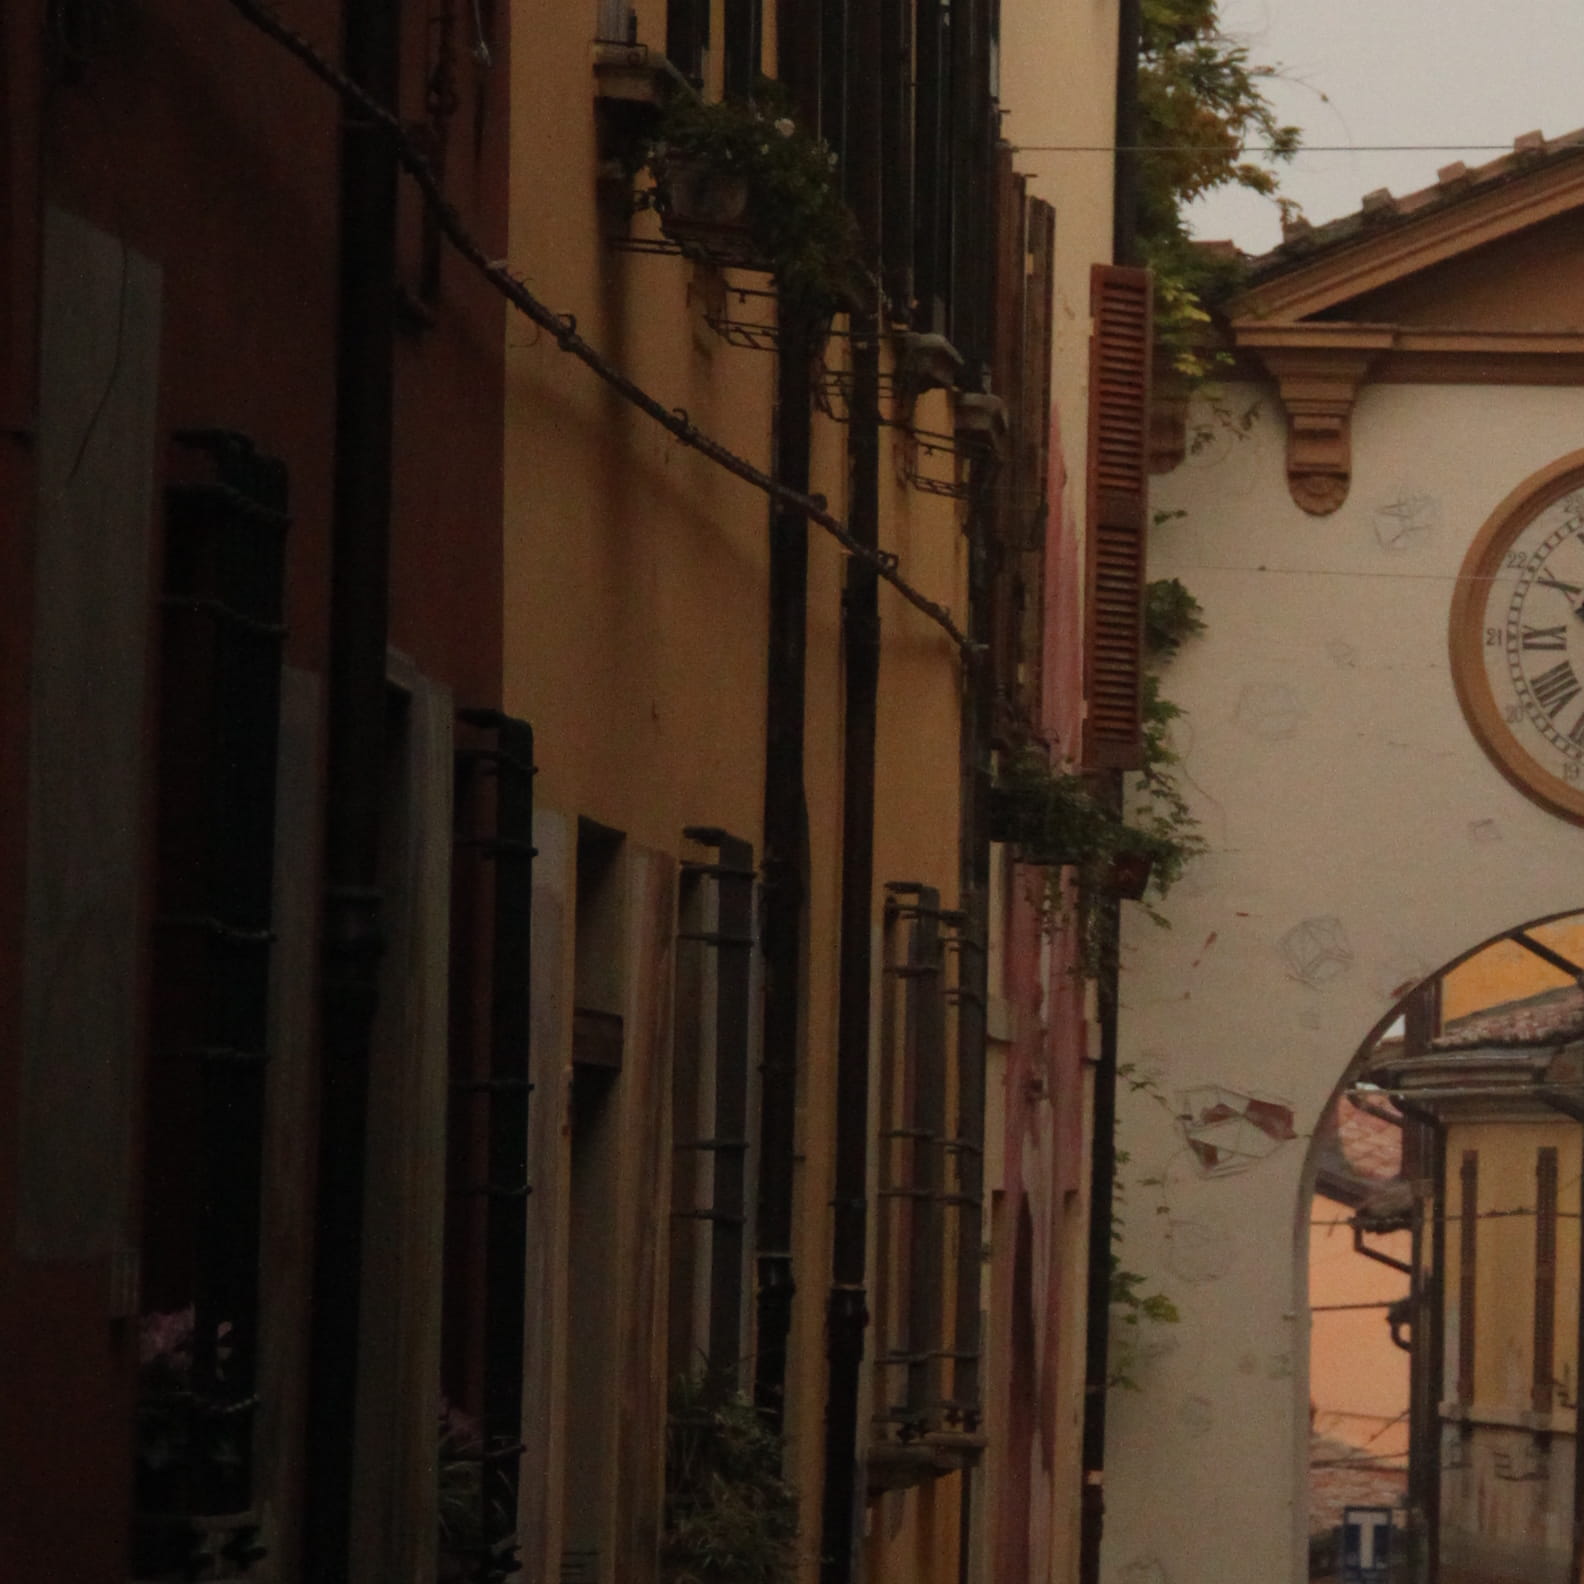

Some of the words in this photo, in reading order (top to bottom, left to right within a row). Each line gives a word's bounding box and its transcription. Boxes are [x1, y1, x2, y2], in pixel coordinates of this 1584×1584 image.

[1506, 551, 1528, 569] 22
[1486, 628, 1503, 646] 21
[1522, 625, 1567, 651] IX
[1564, 762, 1580, 779] 19
